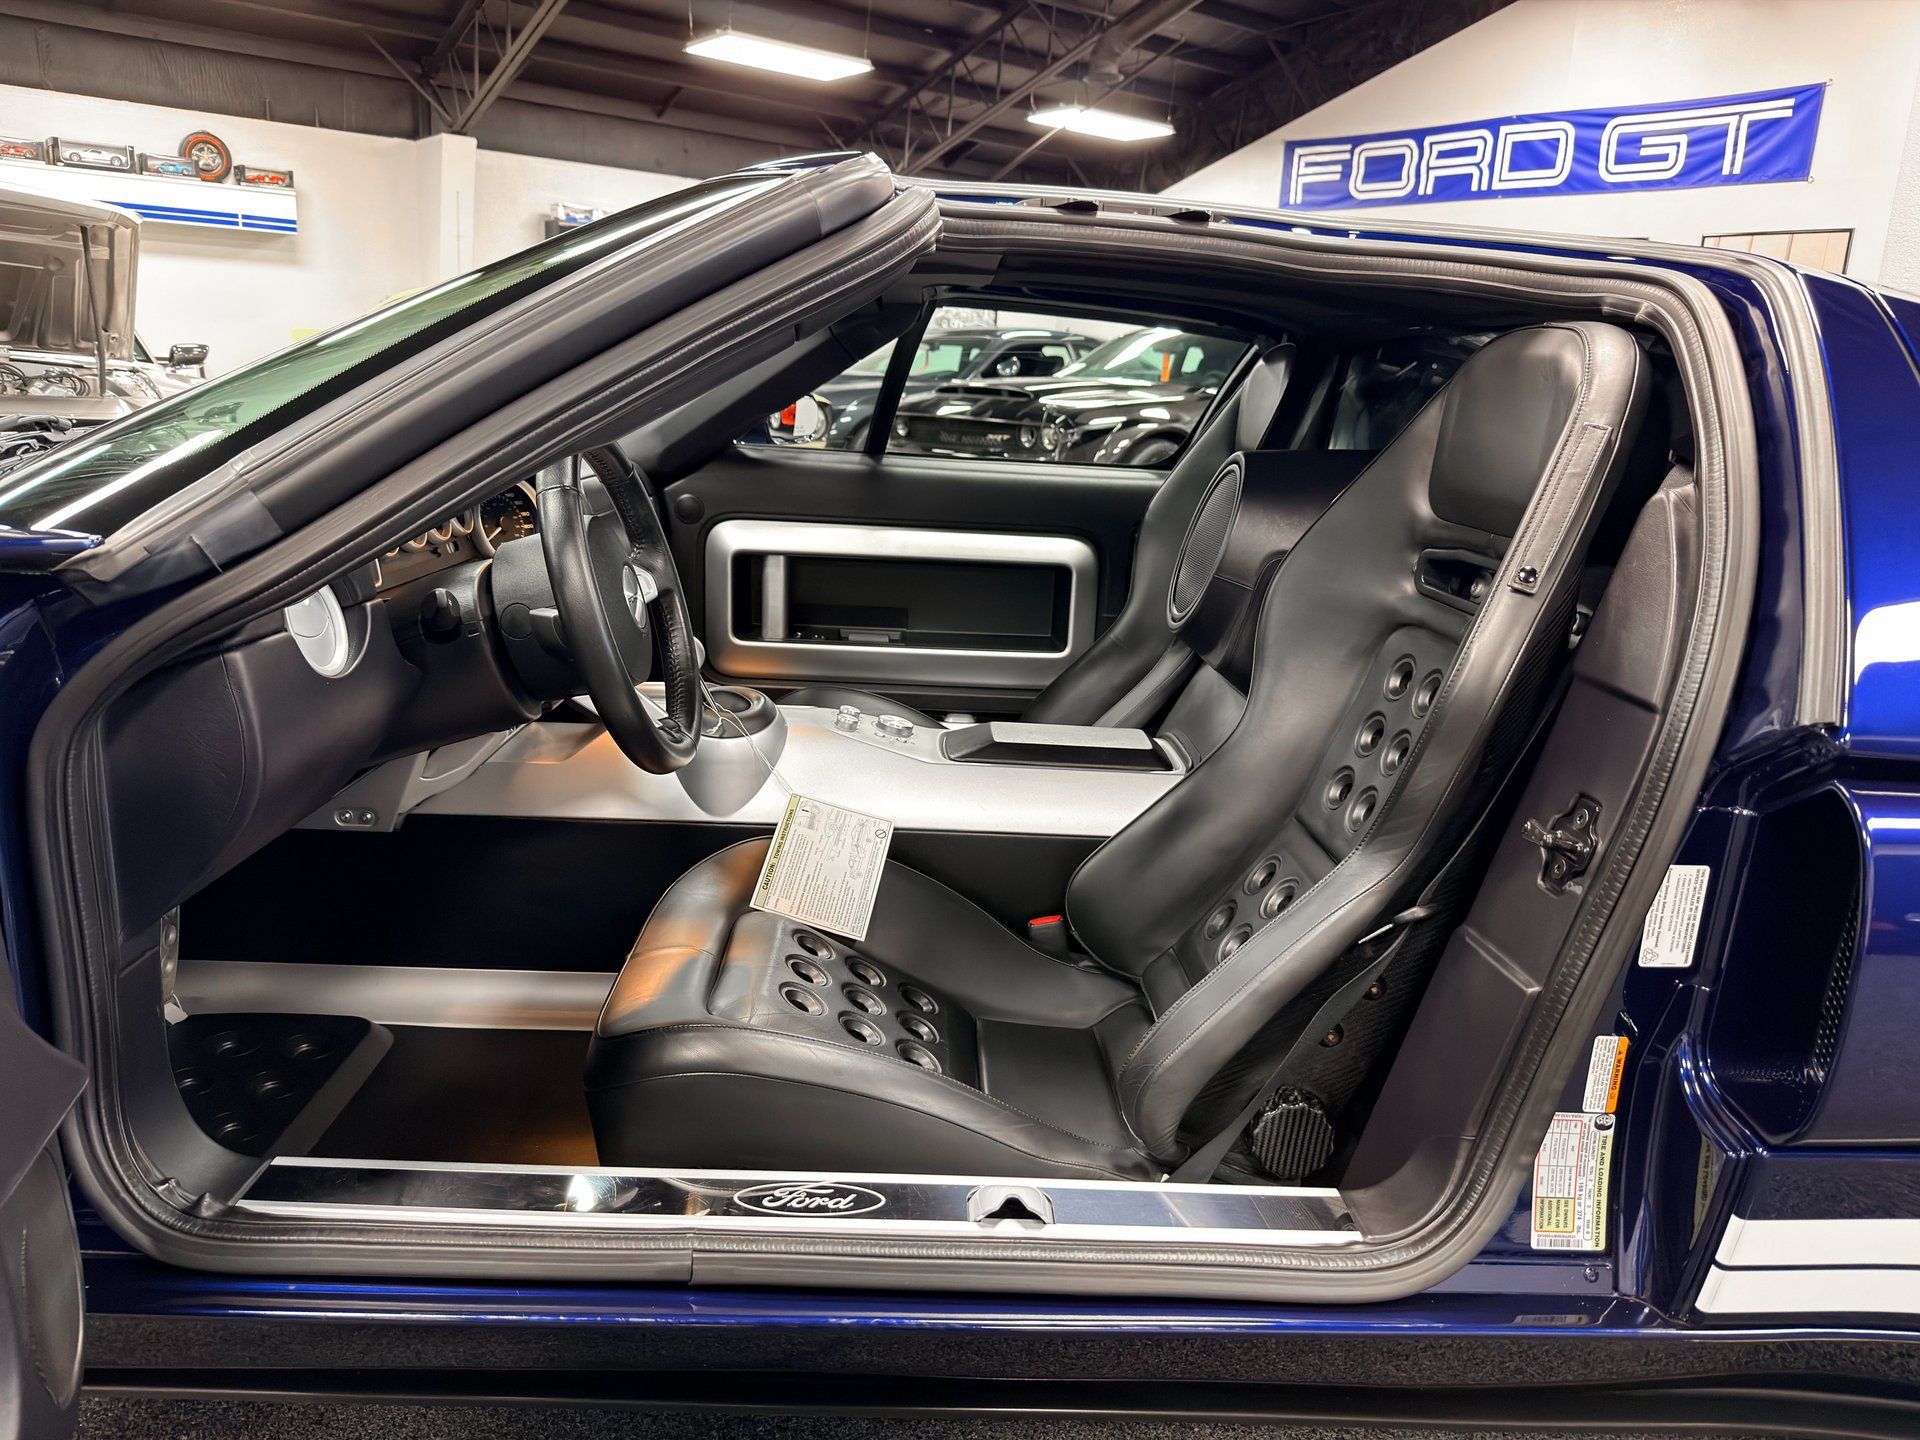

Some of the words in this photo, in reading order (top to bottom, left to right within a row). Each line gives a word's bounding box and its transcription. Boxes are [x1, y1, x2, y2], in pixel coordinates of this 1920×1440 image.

[1289, 121, 1574, 205] FORD
[1598, 98, 1795, 184] GT
[762, 862, 776, 890] CAUTION:
[774, 842, 783, 859] TOWING
[780, 809, 795, 842] INSTRUCTIONS
[1612, 1059, 1621, 1090] WARNING
[761, 1186, 858, 1210] Ford
